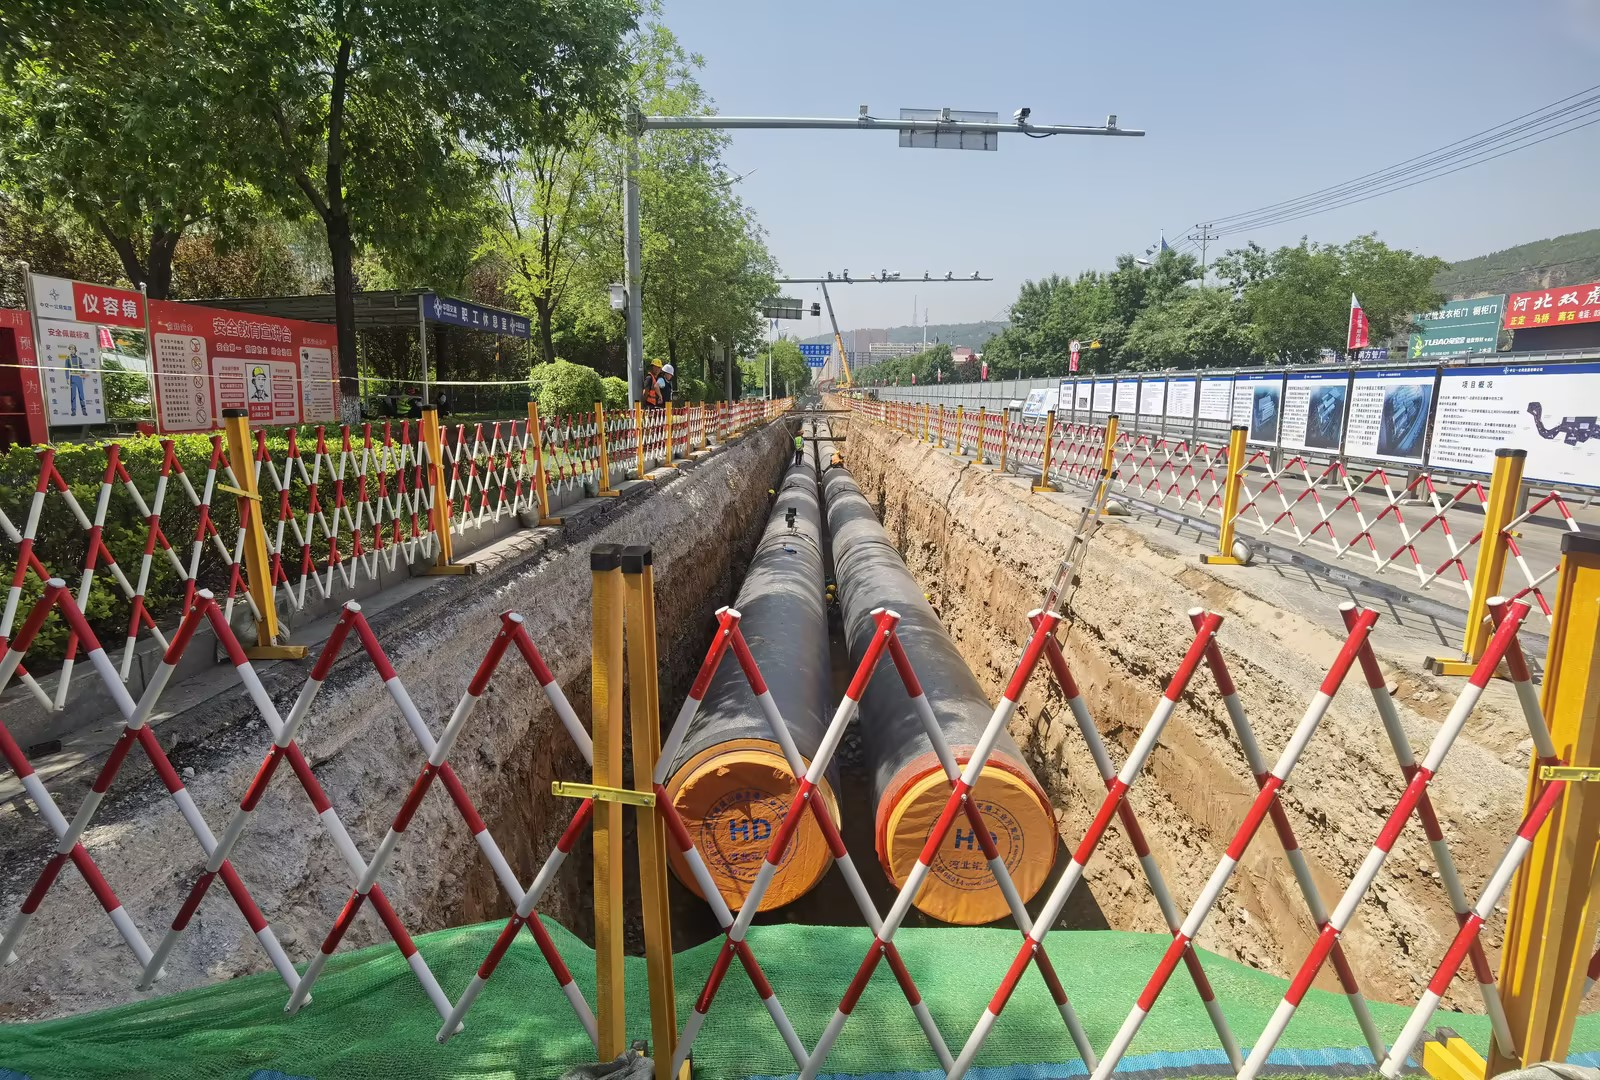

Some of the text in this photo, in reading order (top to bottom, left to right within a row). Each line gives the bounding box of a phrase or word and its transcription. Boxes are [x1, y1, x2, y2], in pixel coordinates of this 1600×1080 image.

[83, 293, 138, 319] 仪容镜
[47, 328, 90, 340] 安全佩戴标准
[212, 316, 292, 343] 安全教育宣讲台
[19, 336, 41, 415] 预防为主
[1462, 380, 1494, 389] 项目概况
[729, 818, 772, 841] HD
